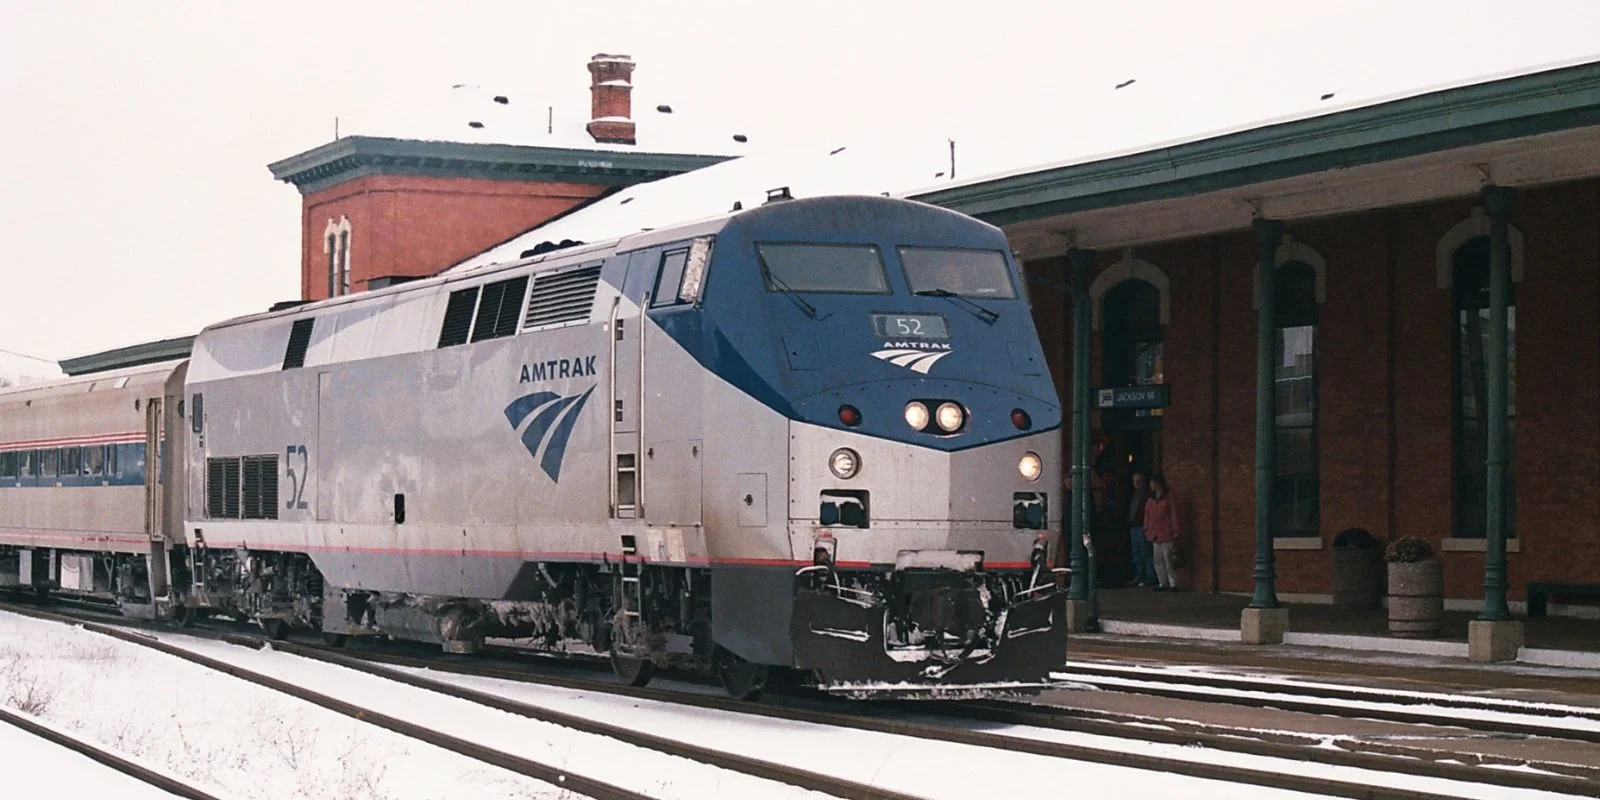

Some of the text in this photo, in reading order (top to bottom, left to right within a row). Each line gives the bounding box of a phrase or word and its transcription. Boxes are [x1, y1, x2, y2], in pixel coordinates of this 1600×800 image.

[896, 318, 925, 335] 52
[883, 341, 952, 350] AMTRAK
[519, 355, 597, 384] AMTRAK
[1116, 391, 1155, 402] JACKSON MI
[286, 444, 308, 510] 52
